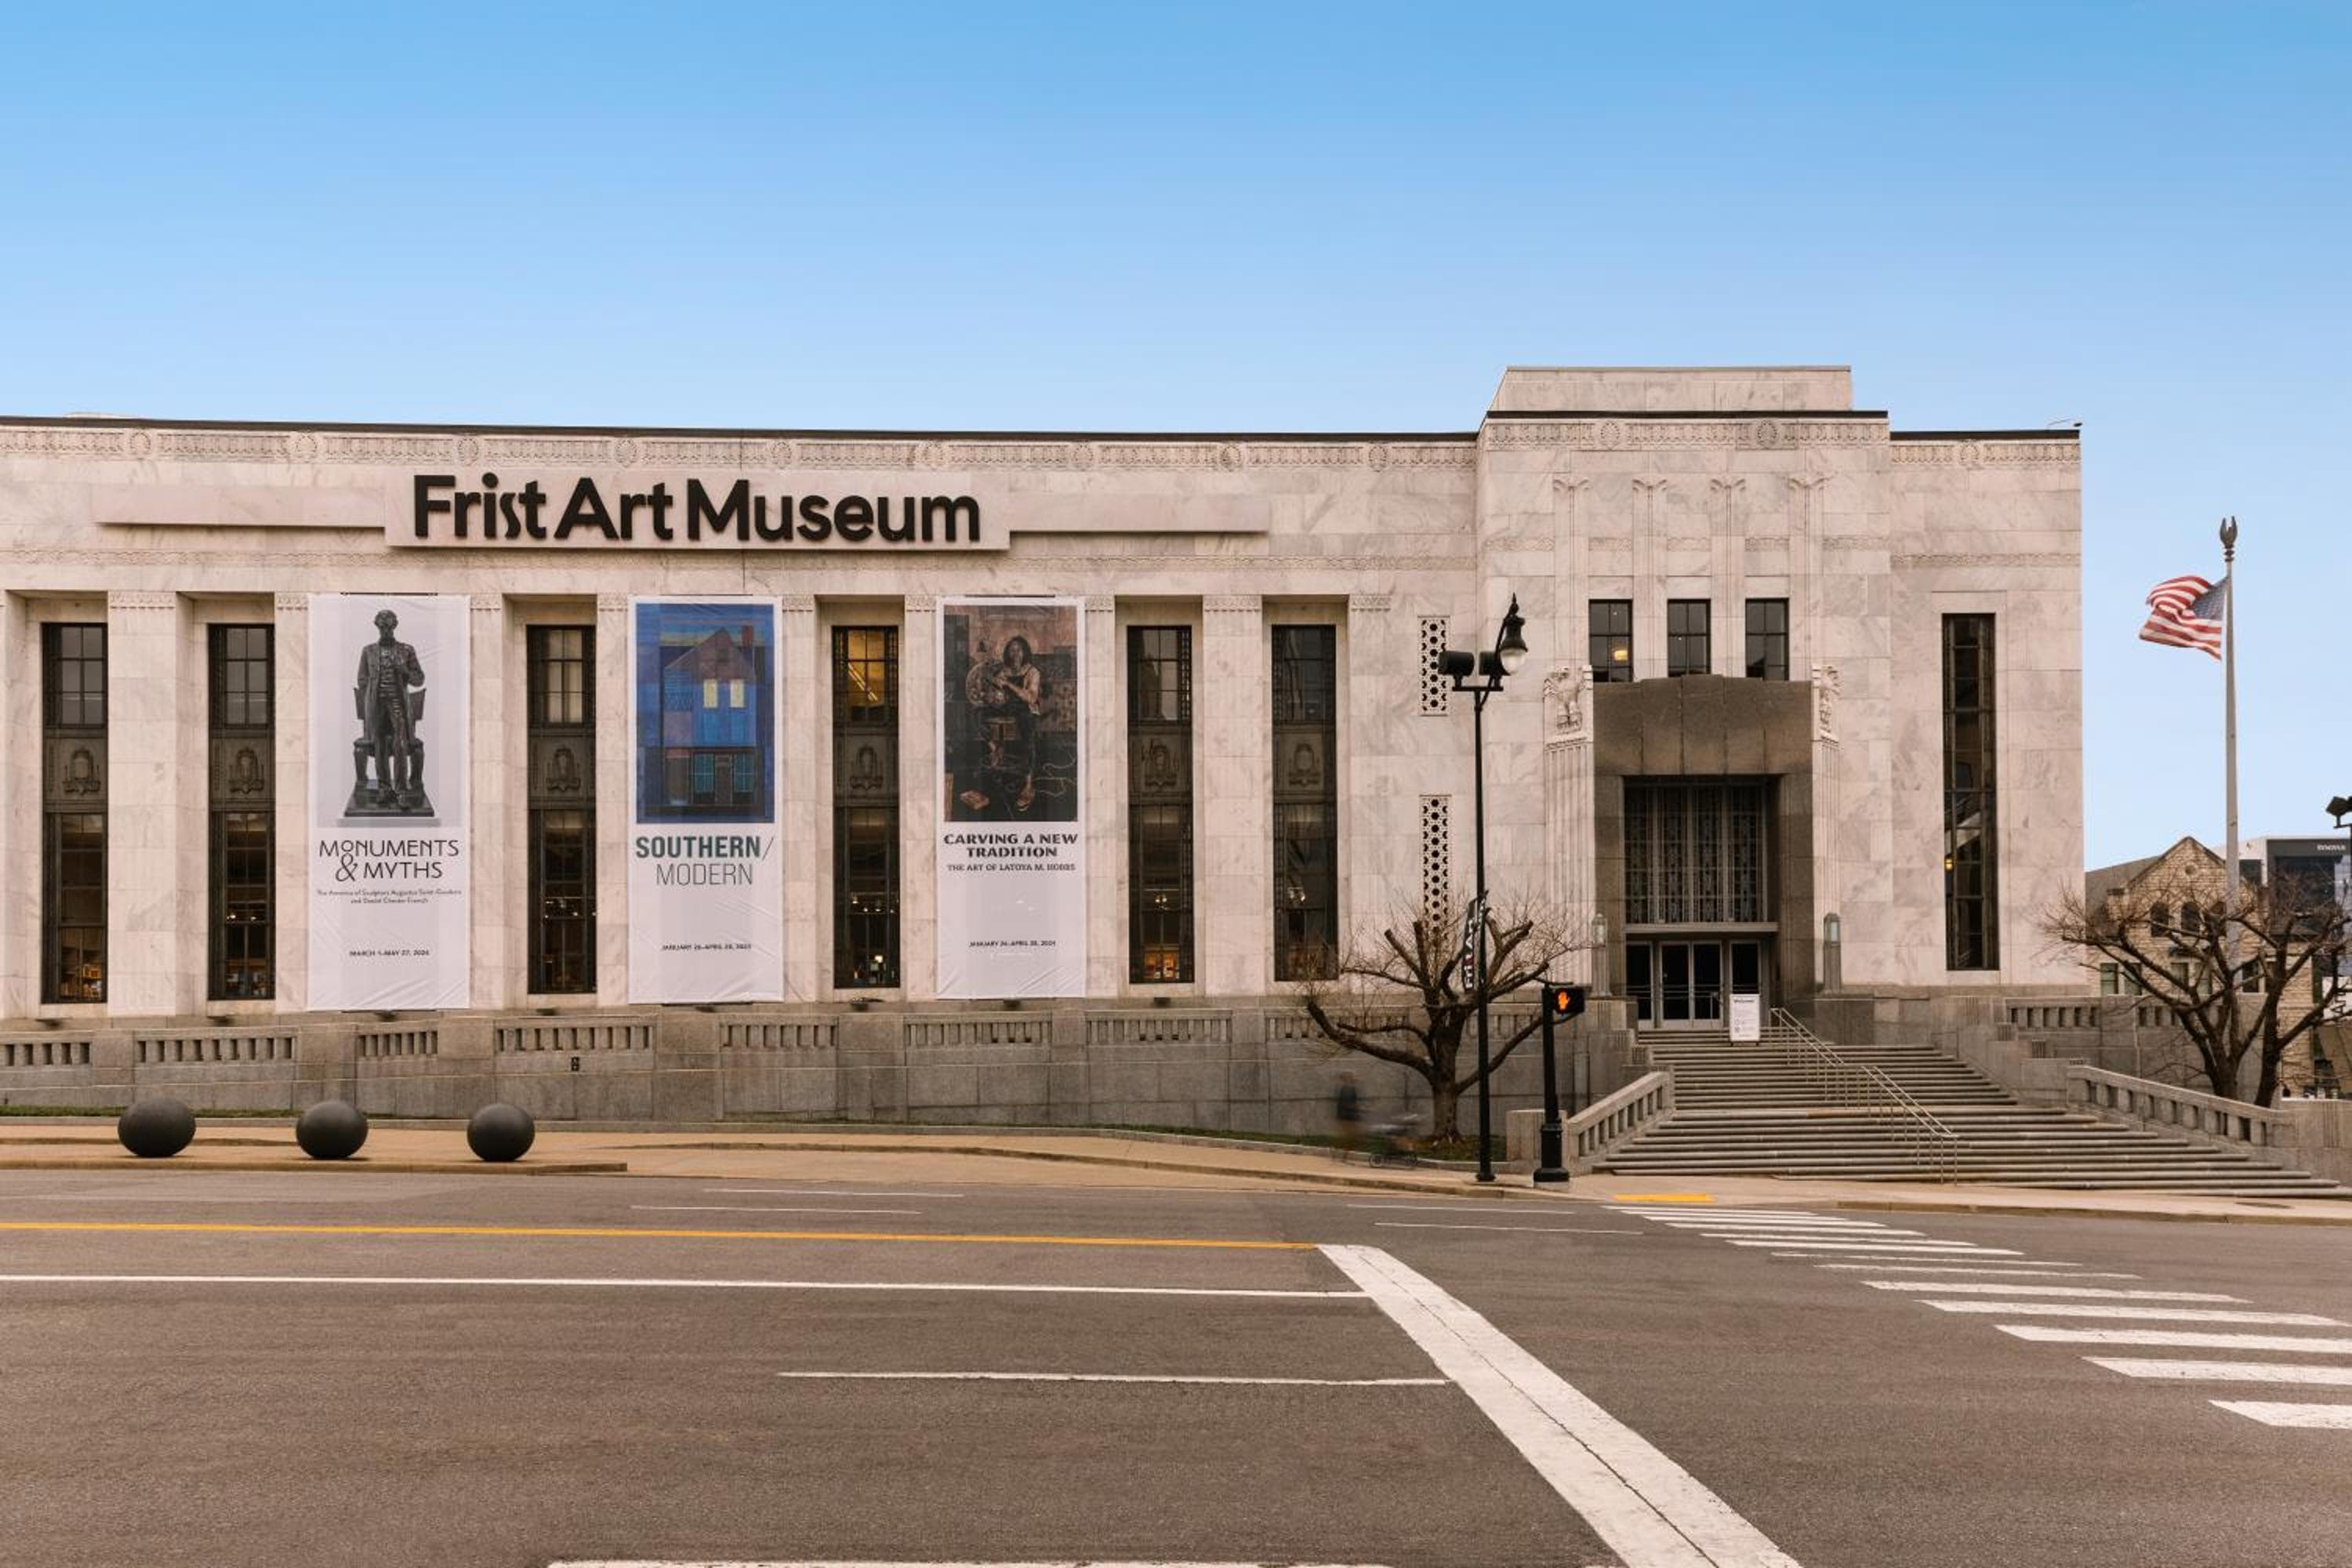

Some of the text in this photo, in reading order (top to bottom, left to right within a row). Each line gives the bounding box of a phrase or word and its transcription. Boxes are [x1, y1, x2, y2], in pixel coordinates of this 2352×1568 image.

[414, 472, 980, 543] Frist Art Museum
[319, 840, 459, 857] MONUMENTS
[943, 833, 1078, 845] CARVING A NEW
[966, 847, 1058, 858] TRADITION
[335, 853, 443, 882] & MYTHS
[656, 863, 753, 886] MODERN
